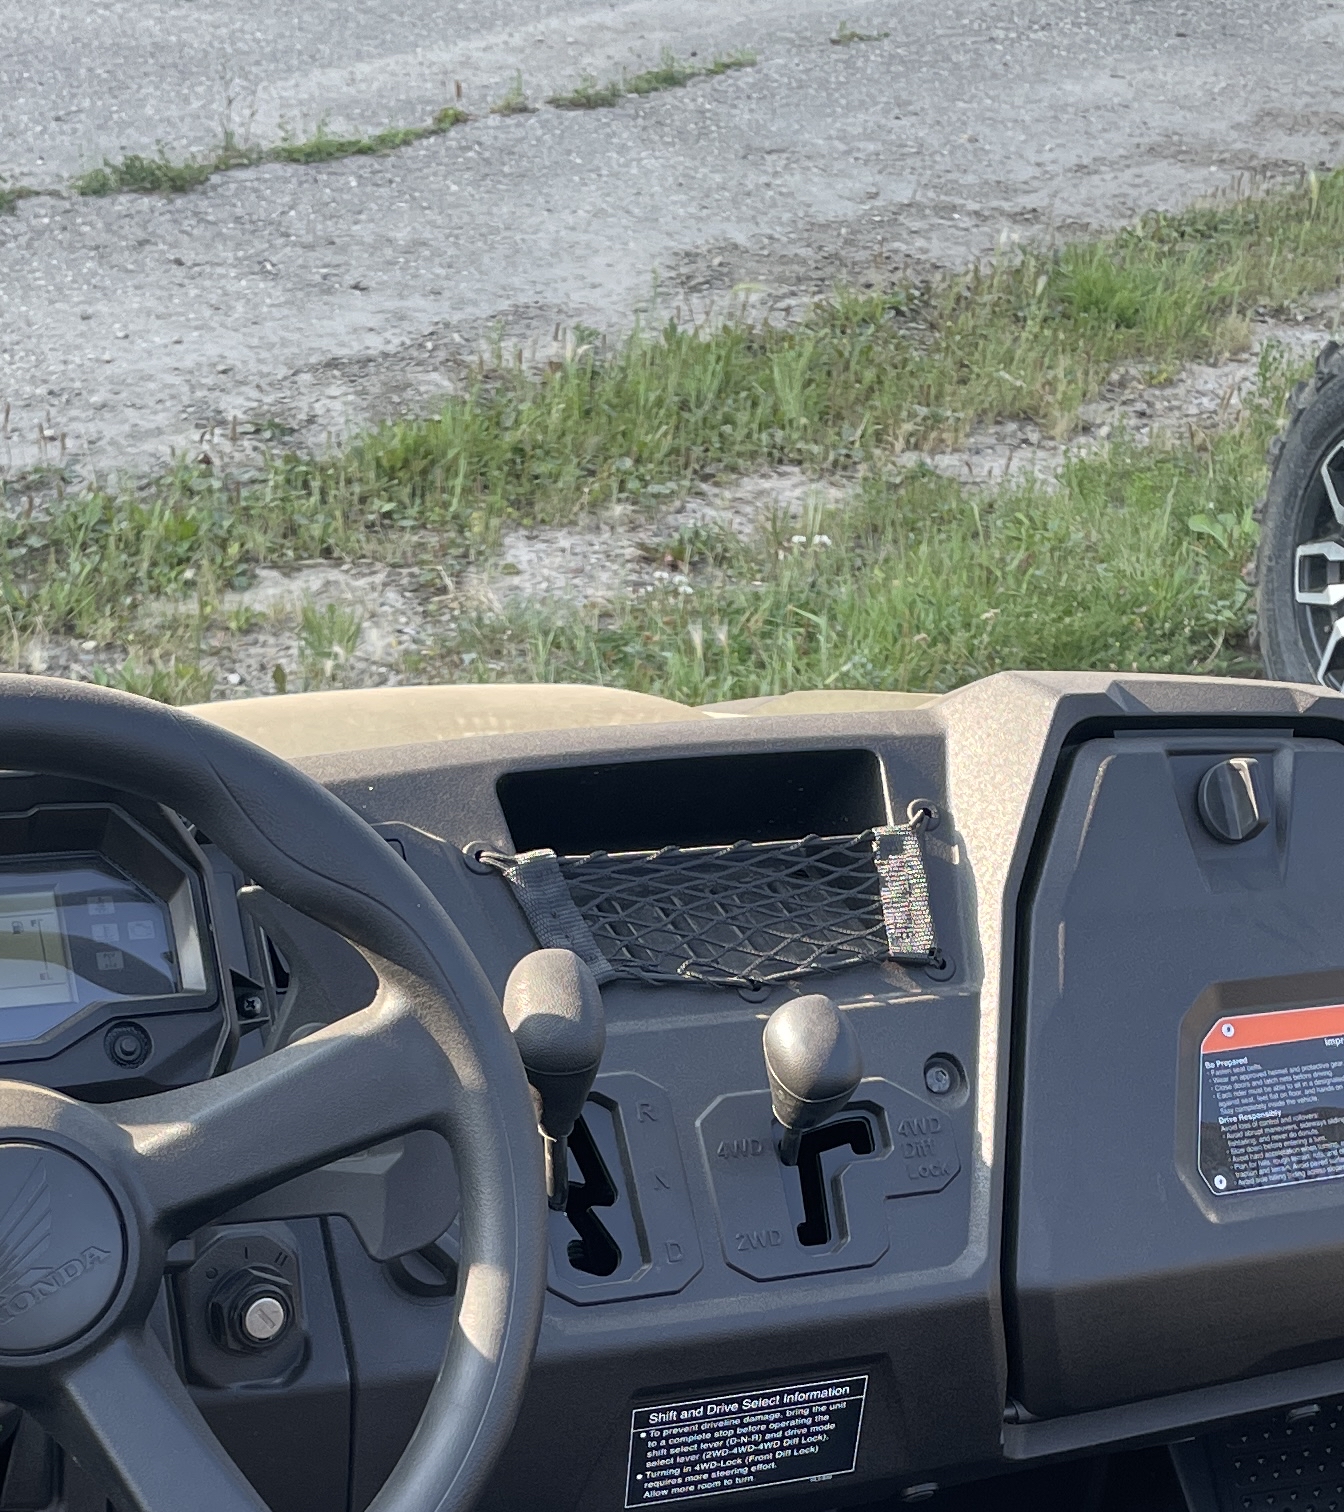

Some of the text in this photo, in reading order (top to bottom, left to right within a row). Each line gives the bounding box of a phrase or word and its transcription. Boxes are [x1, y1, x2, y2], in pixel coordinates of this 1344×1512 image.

[1215, 1057, 1248, 1068] Prepared
[636, 1100, 658, 1123] R
[1218, 1109, 1282, 1124] Drive Responsibly
[898, 1117, 941, 1137] 4WD
[717, 1138, 764, 1160] 4WD
[902, 1139, 936, 1158] Diff
[664, 1239, 684, 1264] D
[736, 1230, 782, 1251] 2WD
[649, 1383, 850, 1424] Shift and Drive Select Information
[647, 1440, 656, 1448] to
[668, 1432, 711, 1446] complete
[713, 1428, 734, 1439] stop
[736, 1423, 766, 1434] before
[768, 1416, 812, 1431] operating
[814, 1413, 829, 1422] the
[648, 1429, 660, 1437] To
[662, 1424, 698, 1437] prevent
[700, 1417, 740, 1430] driveline
[785, 1406, 809, 1418] bring
[812, 1404, 827, 1412] the
[829, 1401, 846, 1410] unit
[646, 1448, 667, 1458] shift
[669, 1443, 698, 1454] select
[700, 1439, 723, 1450] lever
[764, 1430, 782, 1439] and
[784, 1426, 808, 1436] drive
[809, 1421, 836, 1432] mode
[644, 1466, 680, 1480] Turning
[693, 1456, 742, 1471] 4WD-Lock
[744, 1451, 773, 1464] (Front
[775, 1449, 791, 1458] Diff
[793, 1444, 819, 1456] Lock)
[645, 1457, 673, 1468] select
[676, 1453, 699, 1463] lever
[782, 1437, 799, 1446] Diff
[642, 1488, 668, 1498] Allow
[670, 1484, 695, 1494] more
[697, 1480, 721, 1490] room
[723, 1478, 733, 1486] to
[643, 1477, 682, 1490] requires
[684, 1473, 708, 1483] more
[710, 1466, 748, 1480] steering
